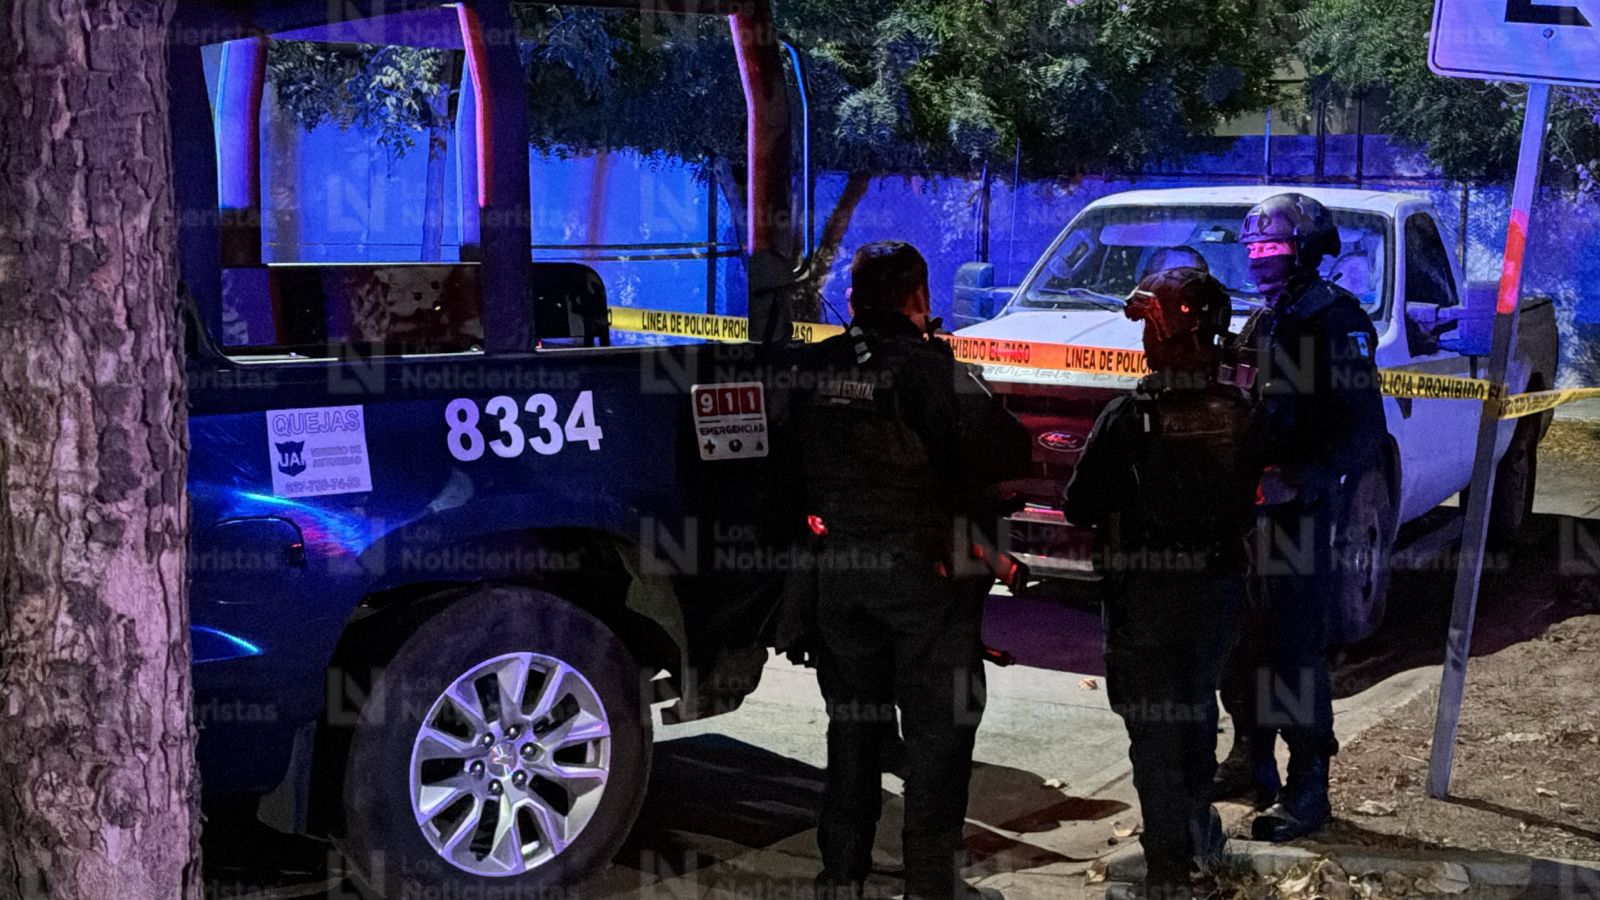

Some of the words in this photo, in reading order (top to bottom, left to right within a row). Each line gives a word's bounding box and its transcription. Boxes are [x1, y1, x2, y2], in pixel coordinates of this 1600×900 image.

[642, 311, 668, 331] LINEA
[670, 314, 682, 333] DE
[684, 315, 719, 338] POLICIA
[989, 341, 1001, 361] EL
[1002, 343, 1030, 364] PASO
[1065, 346, 1096, 370] LINEA
[1099, 350, 1112, 371] DE
[700, 391, 756, 413] 911
[272, 409, 361, 437] QUEJAS
[445, 390, 604, 462] 8334
[699, 423, 766, 436] EMERGENCIAS
